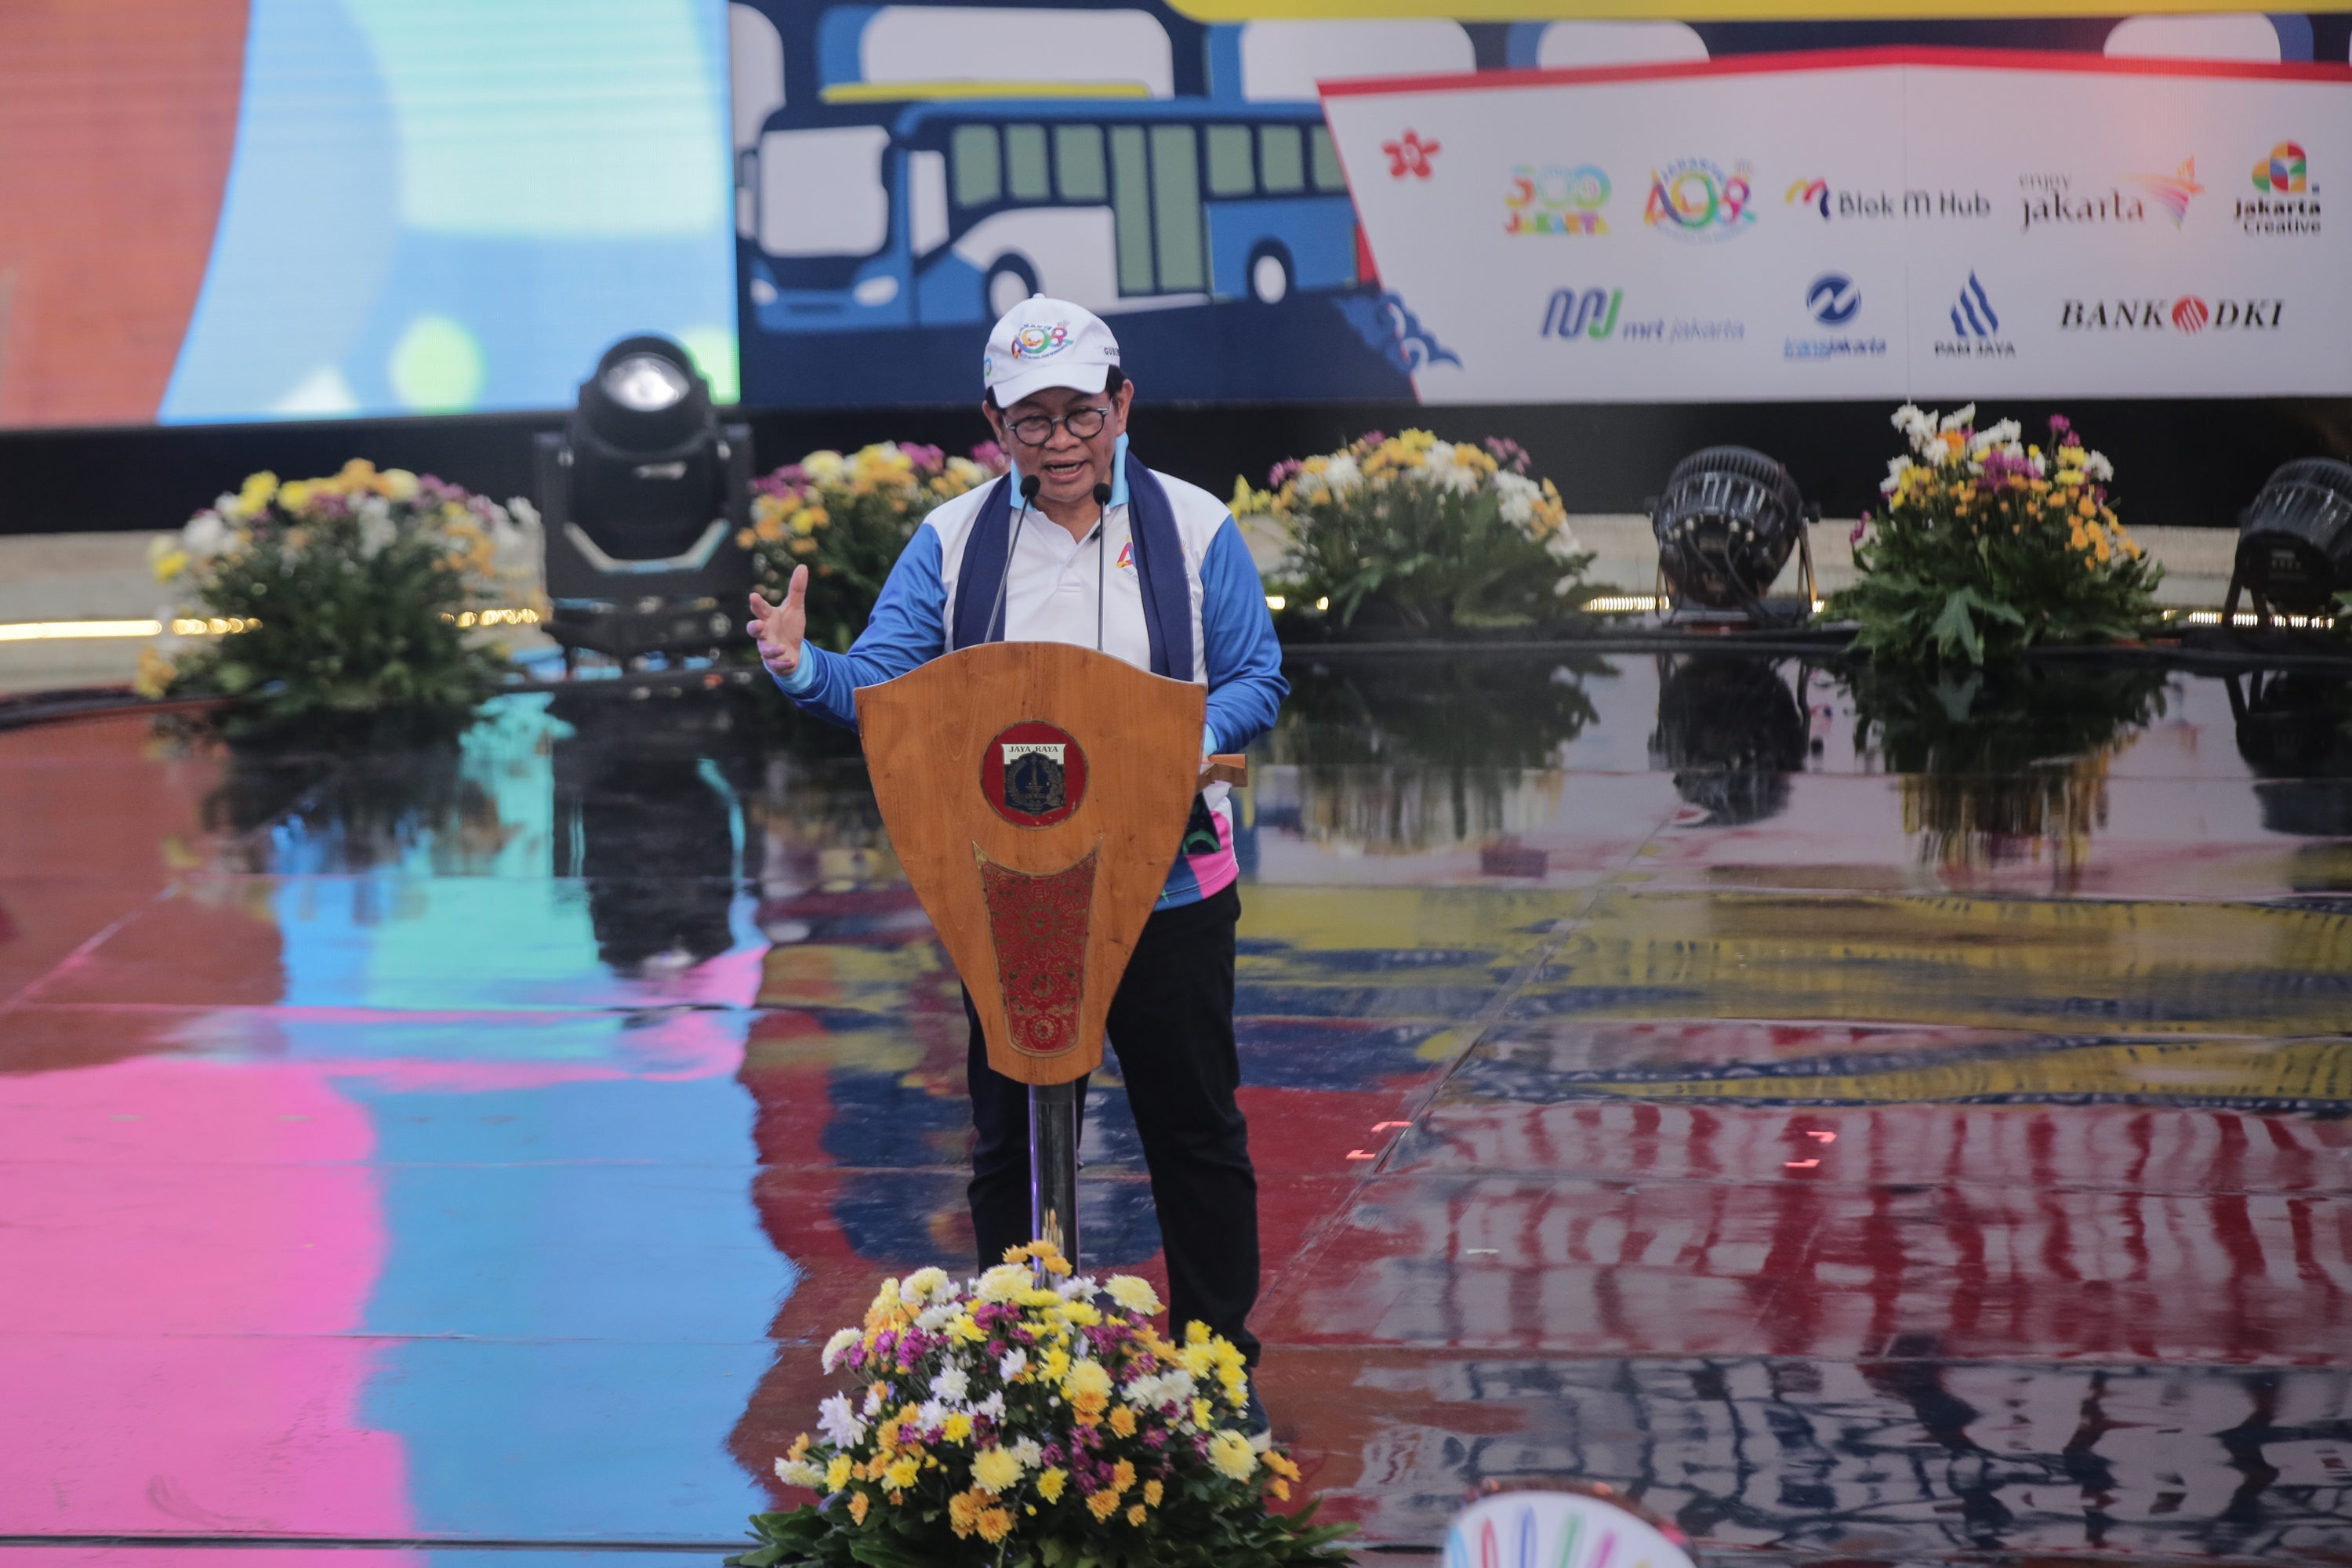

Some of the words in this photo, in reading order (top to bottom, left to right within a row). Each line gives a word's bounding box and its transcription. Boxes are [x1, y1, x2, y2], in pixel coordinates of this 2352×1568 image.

[1839, 193, 1893, 216] Blok
[1904, 192, 1931, 216] M
[1940, 193, 1990, 216] Hub
[2020, 189, 2144, 232] jakarta
[1504, 212, 1610, 234] JAKARTA
[2061, 299, 2166, 329] BANK
[2215, 299, 2285, 329] DKI
